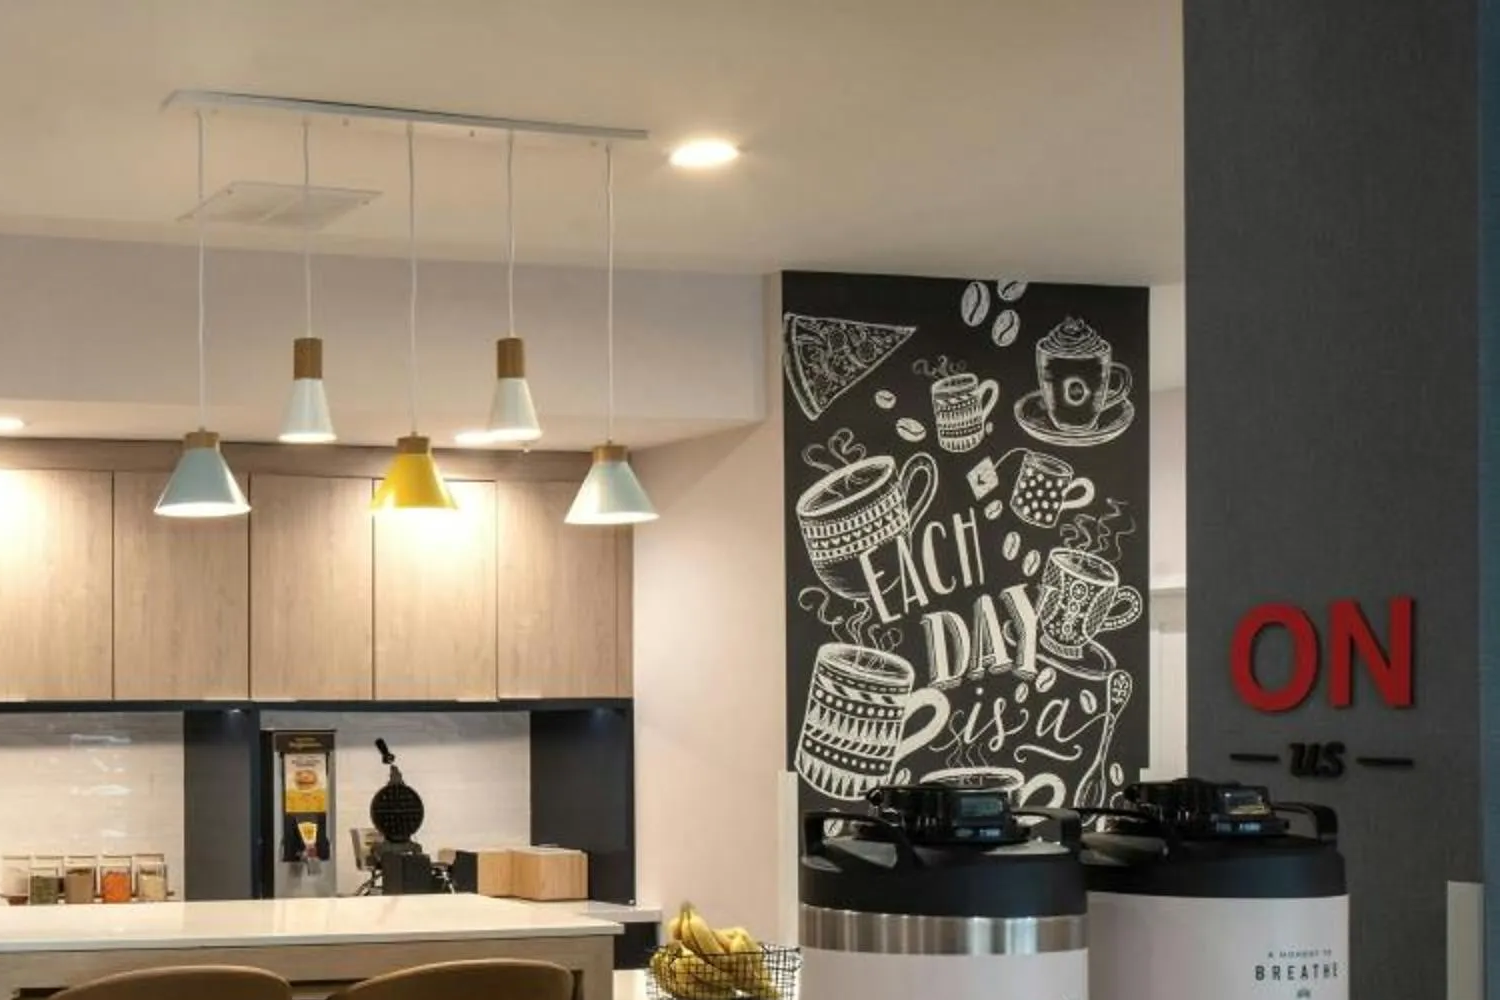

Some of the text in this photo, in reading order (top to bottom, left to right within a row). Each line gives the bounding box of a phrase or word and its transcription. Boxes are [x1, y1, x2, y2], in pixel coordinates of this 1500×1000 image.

[859, 506, 985, 624] EACH
[919, 583, 1040, 690] DAY
[1229, 595, 1415, 714] ON
[930, 686, 1029, 752] is
[1255, 961, 1338, 982] BREATHE
